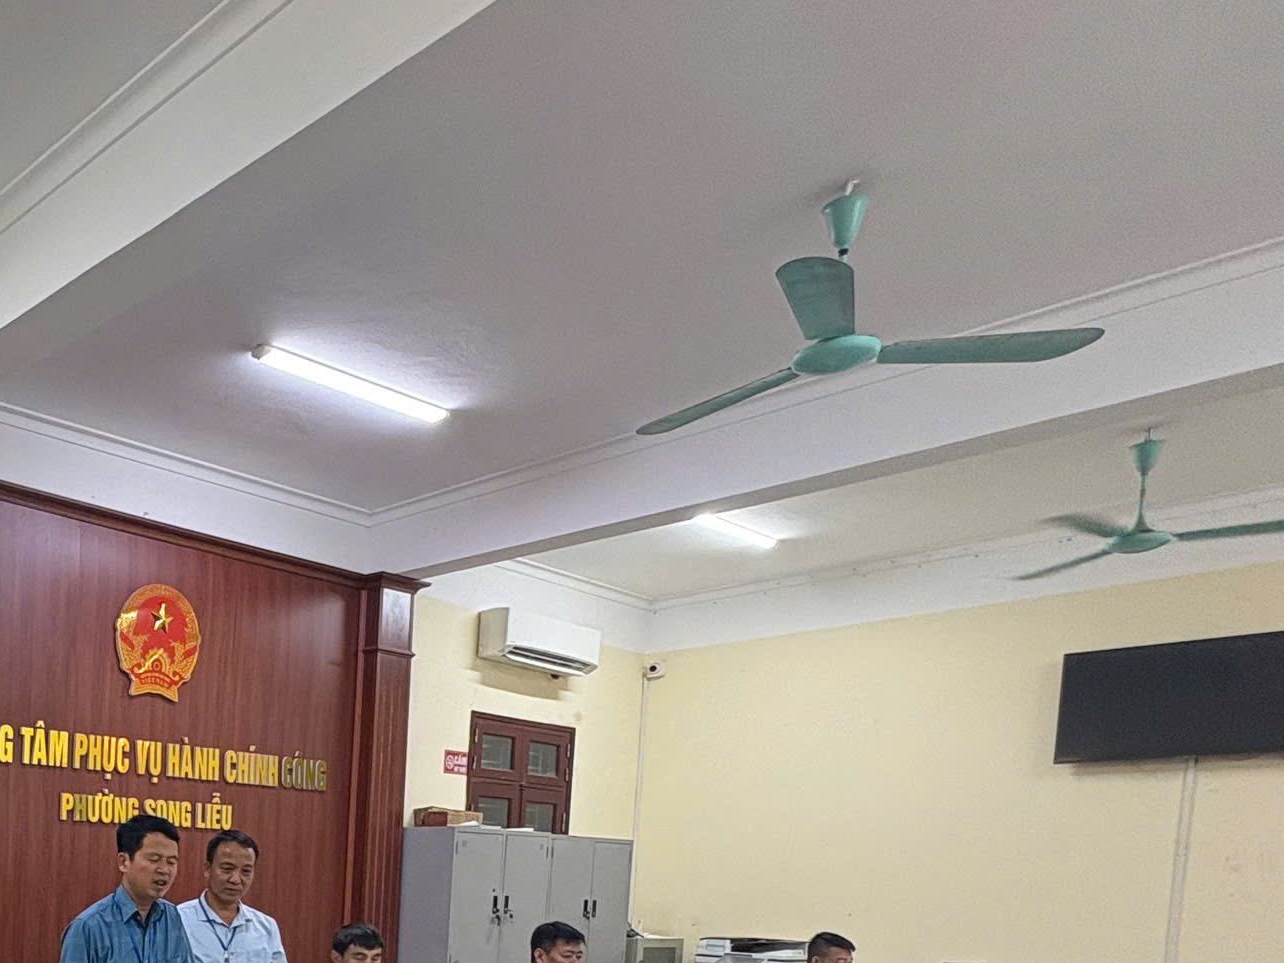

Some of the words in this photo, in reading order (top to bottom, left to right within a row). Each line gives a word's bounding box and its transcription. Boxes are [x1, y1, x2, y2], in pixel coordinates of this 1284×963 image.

[20, 720, 69, 767] TÂM
[73, 733, 130, 780] PHỤC
[136, 739, 162, 783] VỤ
[166, 737, 220, 782] HÀNH
[224, 745, 279, 787] CHÍNH
[60, 788, 140, 824] PHƯỜNG
[143, 799, 192, 828] SONG
[195, 792, 232, 831] LIỄU
